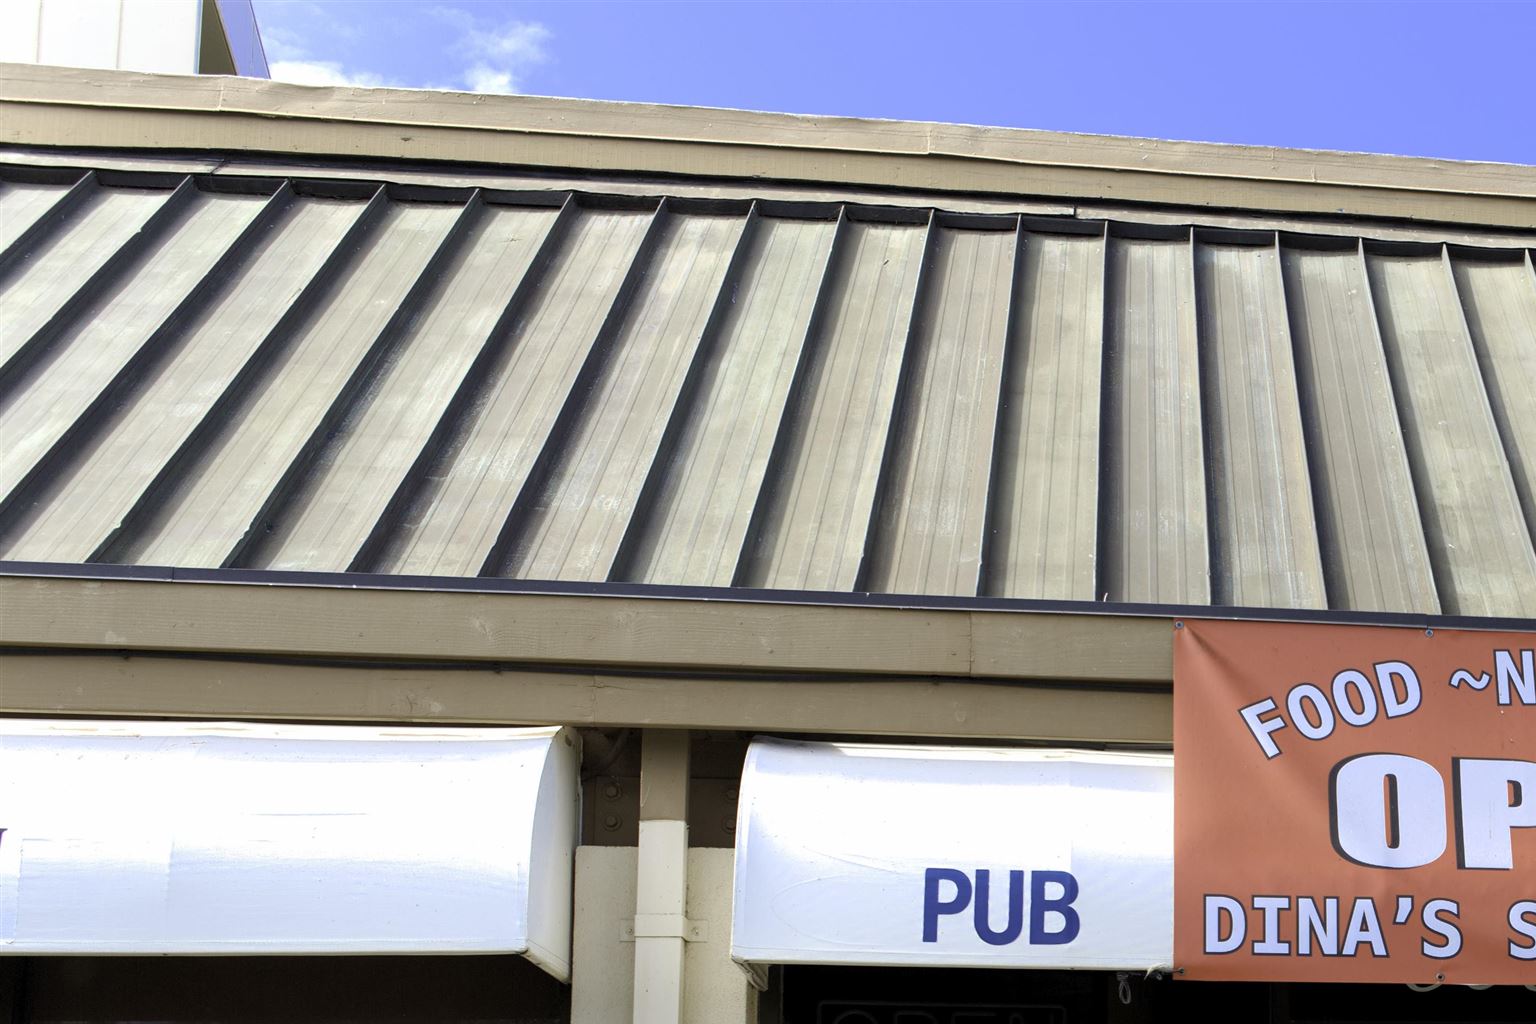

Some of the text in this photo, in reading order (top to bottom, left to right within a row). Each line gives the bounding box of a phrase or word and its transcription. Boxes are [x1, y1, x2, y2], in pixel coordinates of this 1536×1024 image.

[1240, 660, 1423, 760] FOOD
[922, 867, 1081, 946] PUB
[1203, 894, 1464, 960] DINA'S
